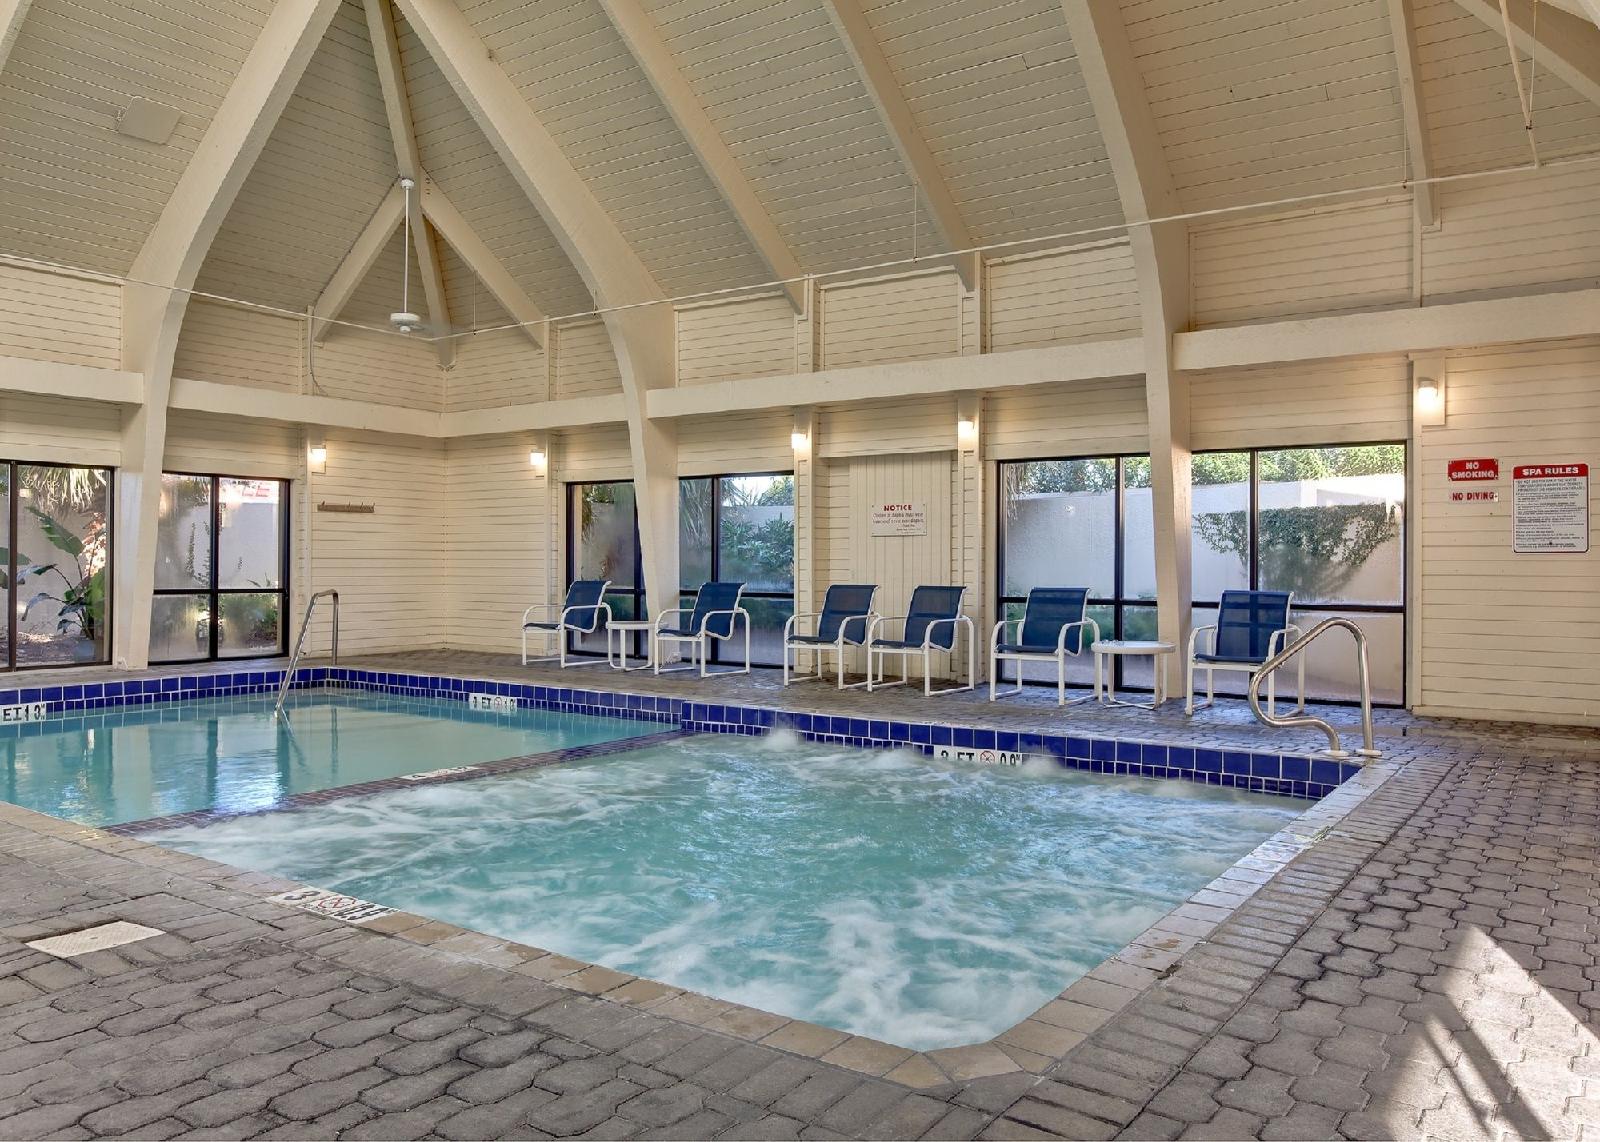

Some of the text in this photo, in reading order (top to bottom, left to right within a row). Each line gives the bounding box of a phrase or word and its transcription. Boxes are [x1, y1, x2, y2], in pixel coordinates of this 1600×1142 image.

[1465, 461, 1479, 470] NO
[1451, 470, 1495, 479] SMOKING
[1522, 466, 1579, 476] SPA RULES
[1452, 491, 1494, 501] NO DIVING
